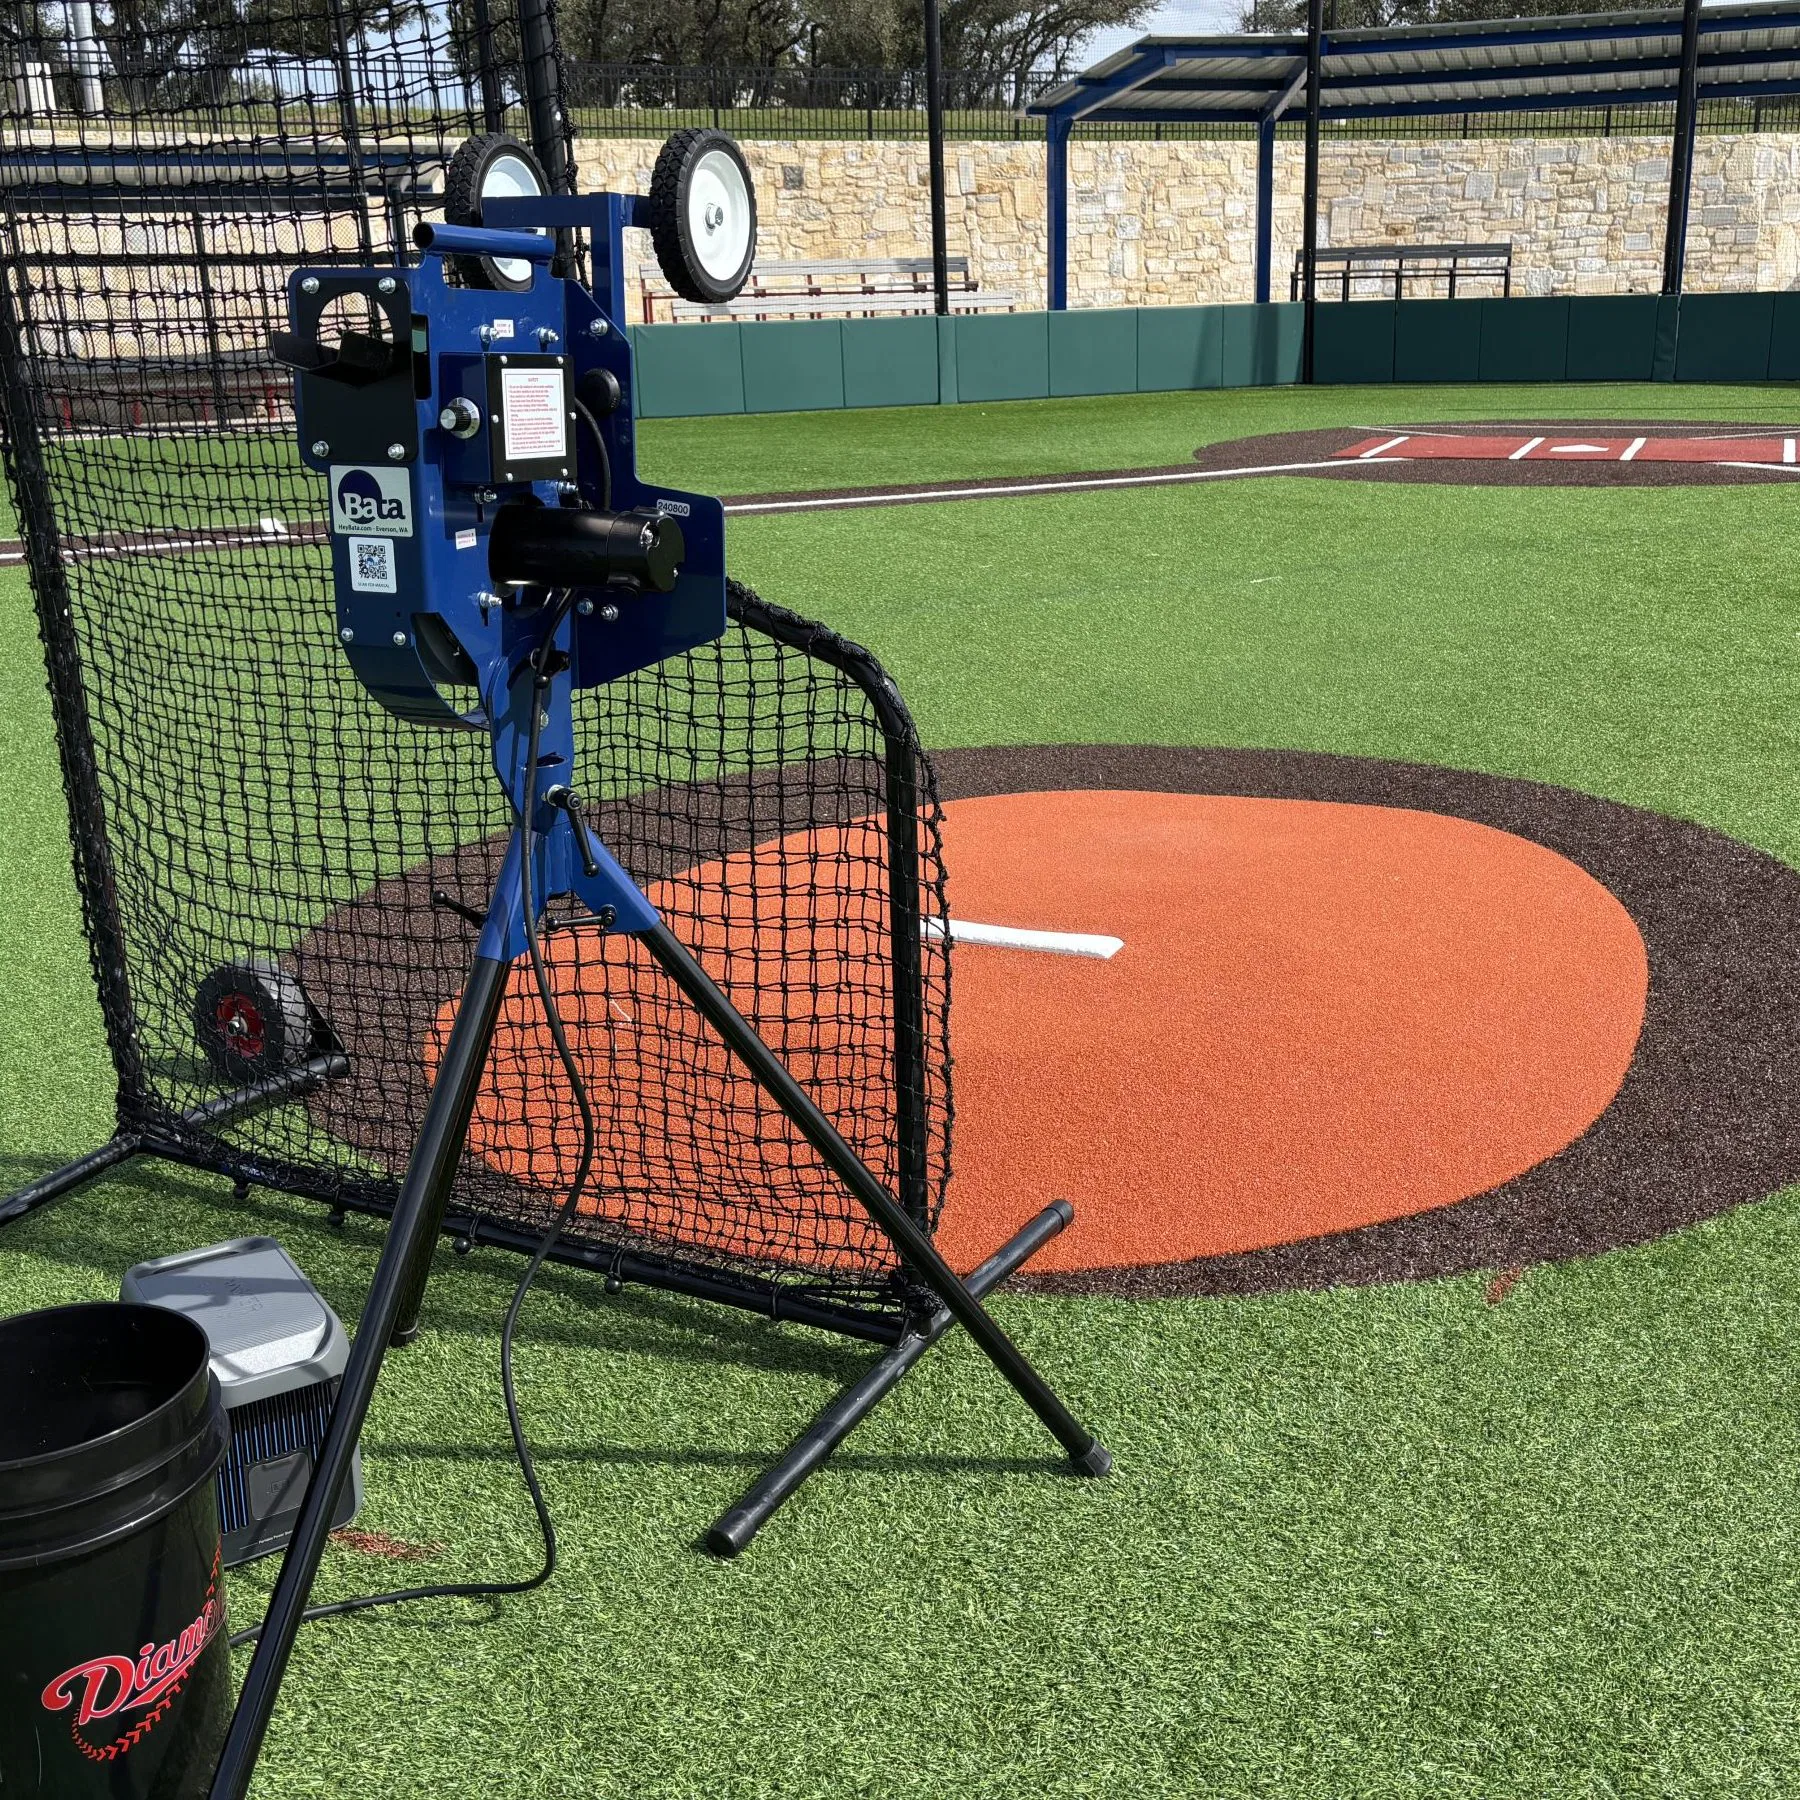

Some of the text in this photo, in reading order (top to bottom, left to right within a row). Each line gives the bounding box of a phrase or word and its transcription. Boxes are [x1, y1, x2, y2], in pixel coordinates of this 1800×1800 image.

[343, 492, 406, 520] Bata
[657, 501, 689, 515] 240800
[338, 524, 372, 532] HeyBata.com
